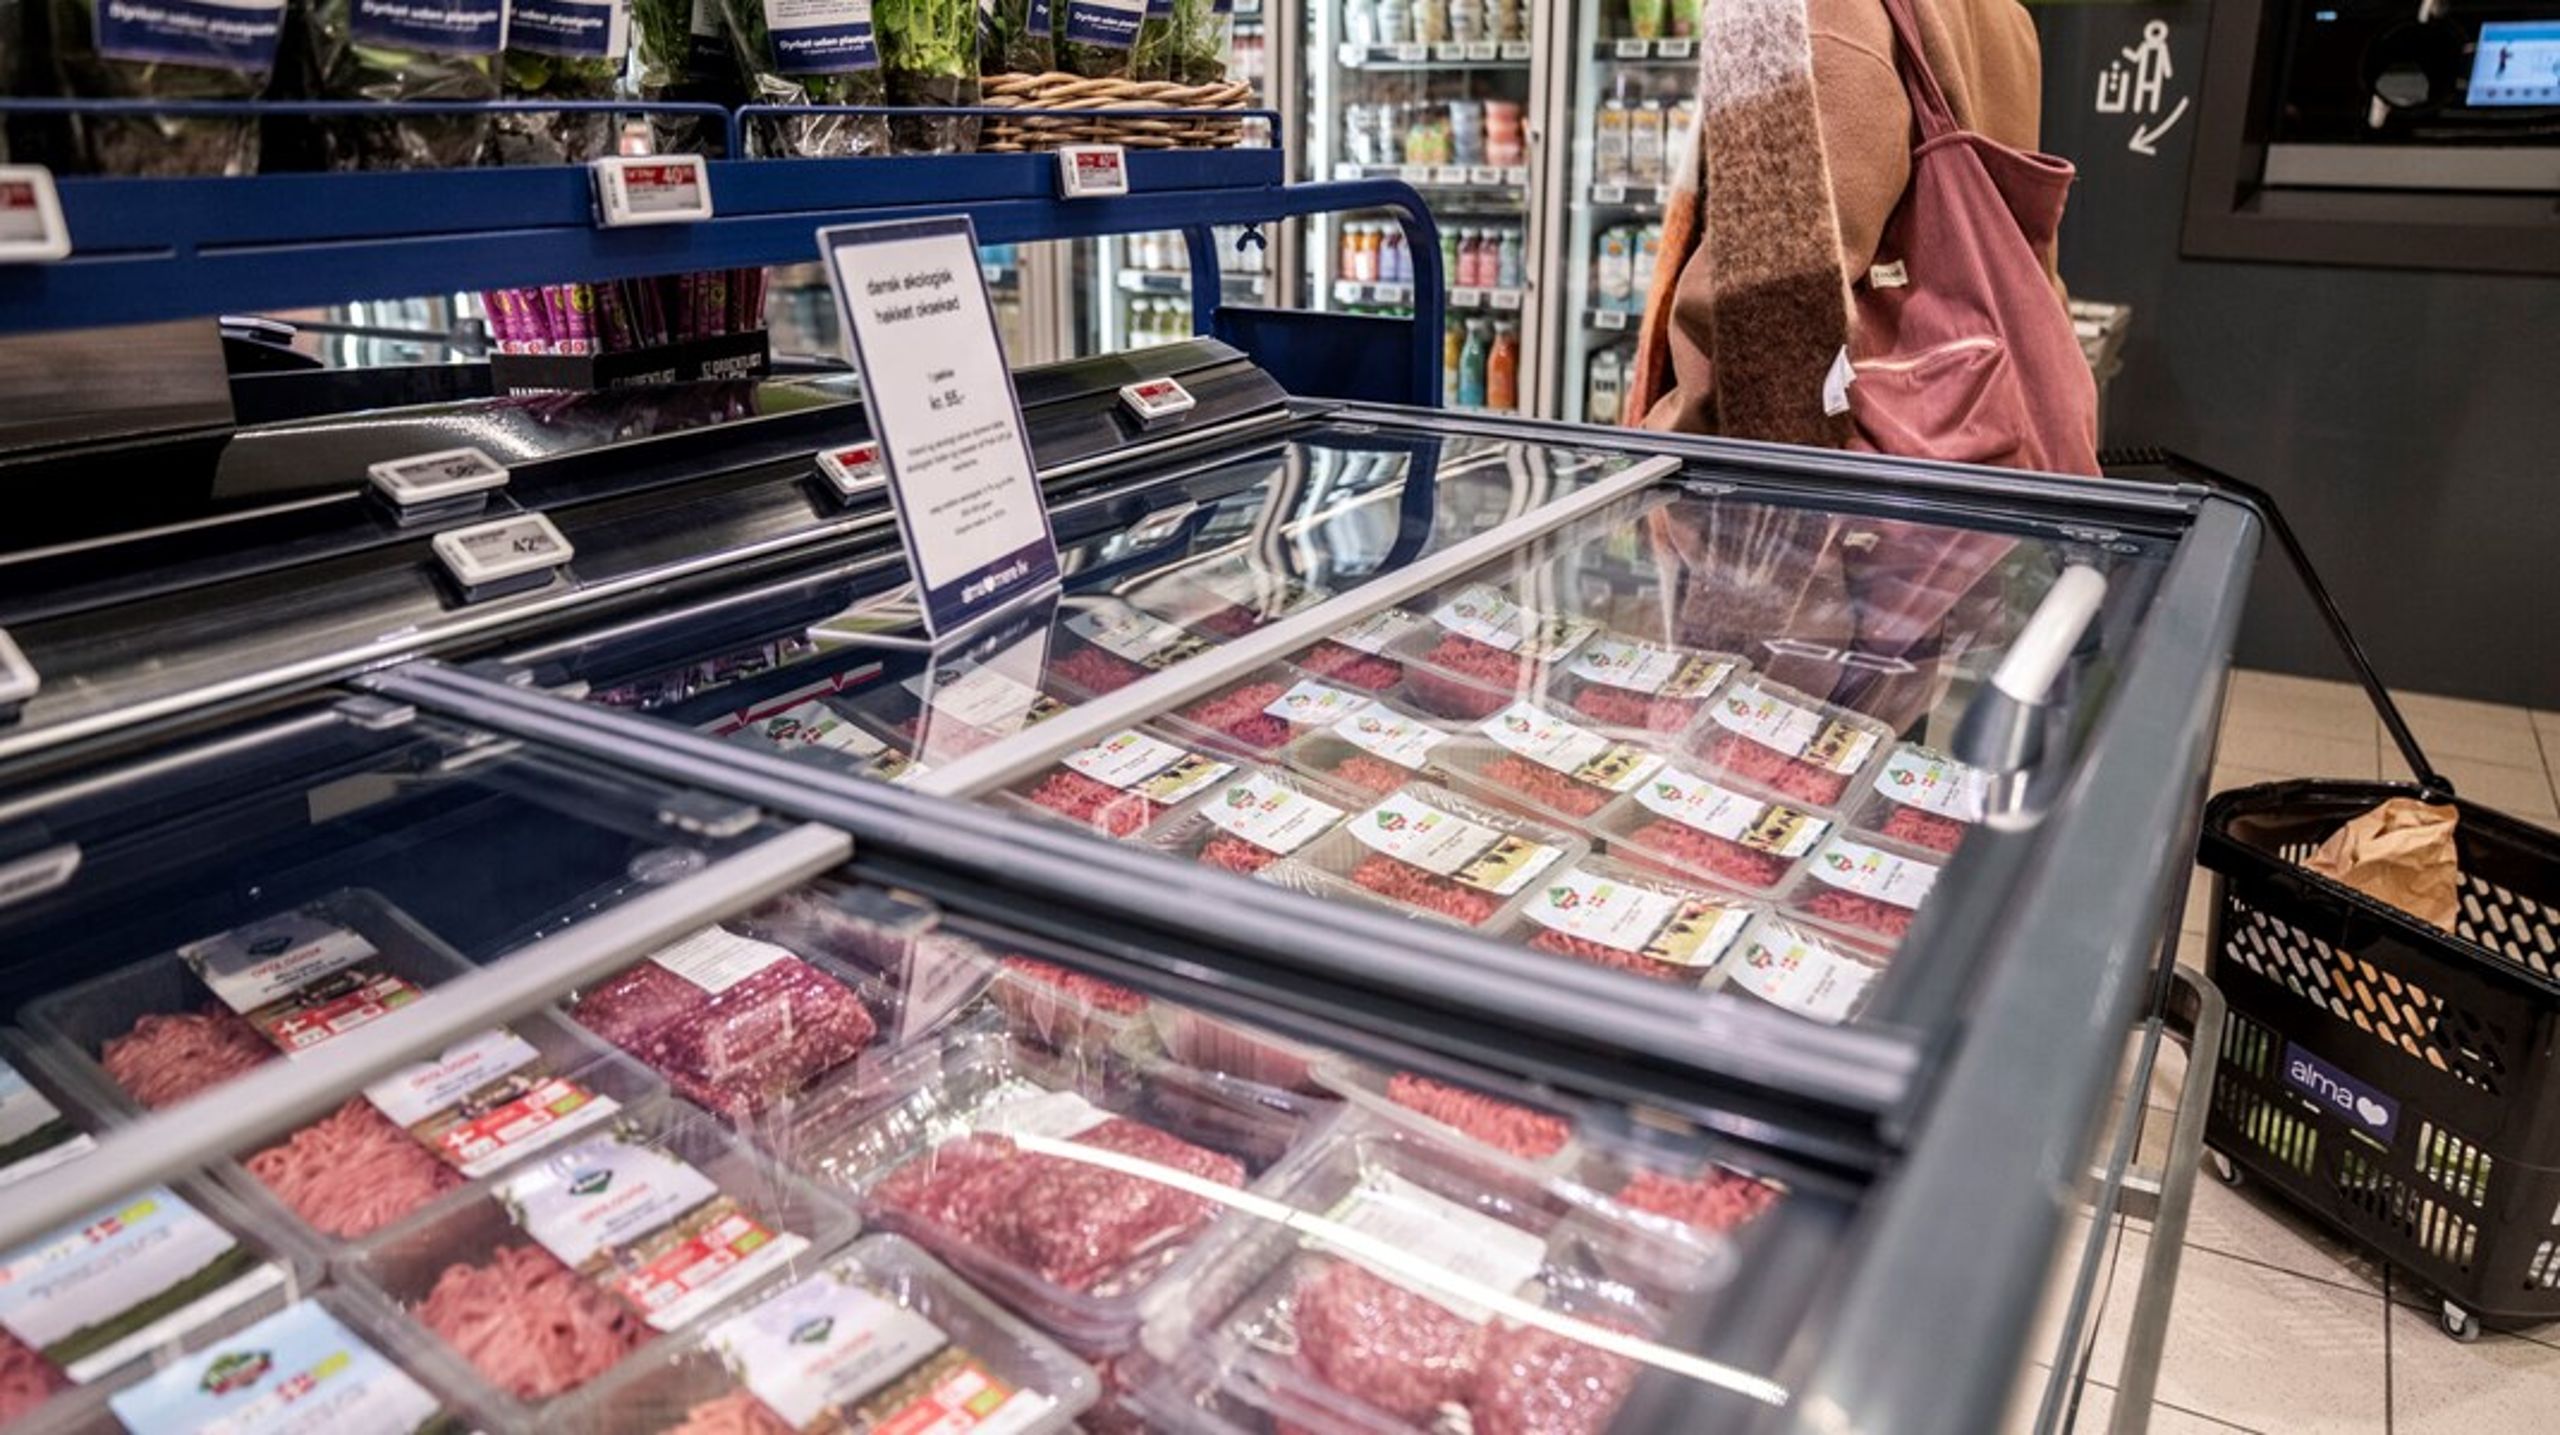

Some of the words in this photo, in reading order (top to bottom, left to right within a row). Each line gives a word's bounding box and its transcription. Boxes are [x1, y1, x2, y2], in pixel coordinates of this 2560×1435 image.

[867, 278, 901, 296] dansk
[875, 304, 914, 324] hakket
[2291, 1060, 2354, 1111] alma
